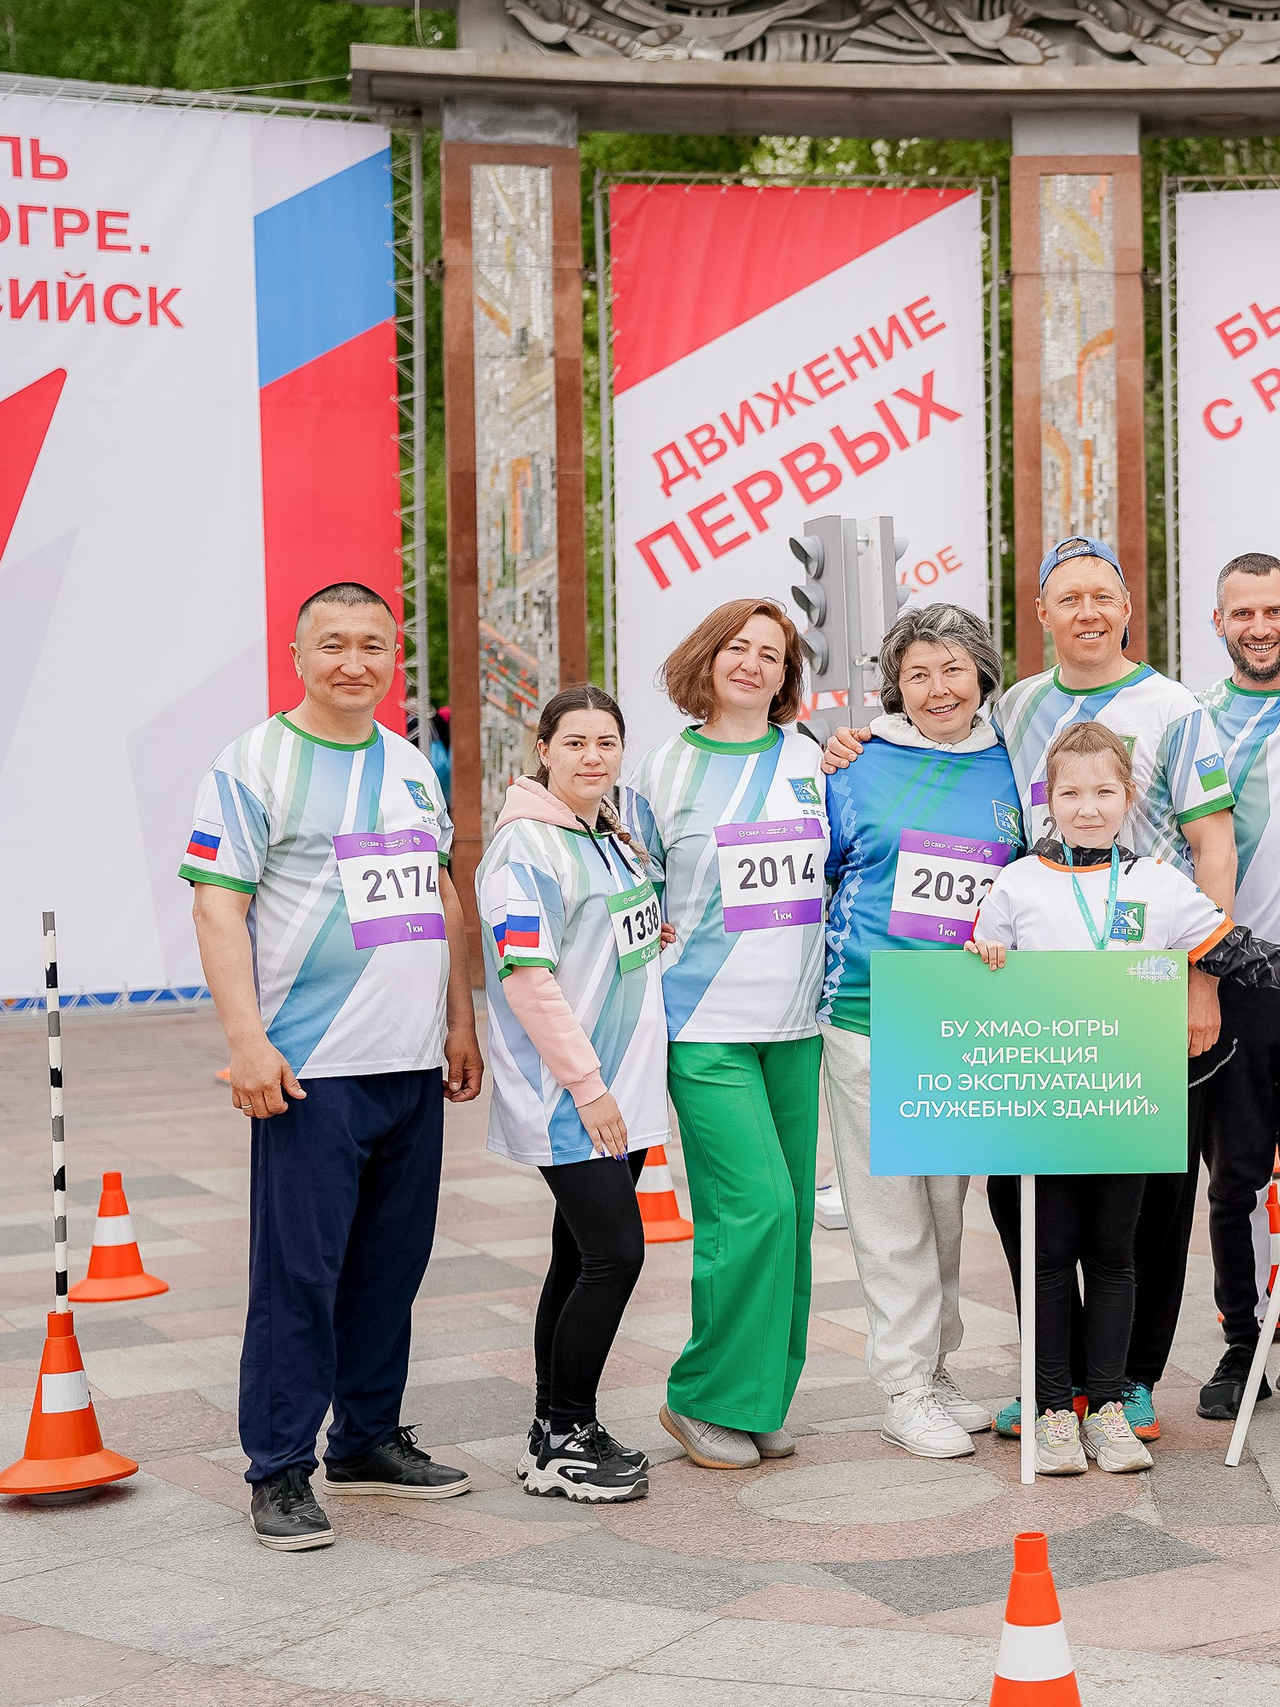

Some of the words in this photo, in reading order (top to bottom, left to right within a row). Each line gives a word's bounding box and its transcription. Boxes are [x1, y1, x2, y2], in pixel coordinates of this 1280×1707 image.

[0, 204, 150, 252] ГРЕ.
[0, 270, 184, 328] ИЙСК
[651, 295, 947, 498] ДВИЖЕНИЕ
[1202, 398, 1244, 442] С
[634, 369, 963, 592] ПЕРВЫХ
[361, 865, 437, 902] 2174
[737, 853, 815, 890] 2014
[622, 901, 659, 945] 1338
[940, 1020, 969, 1038] БУ
[974, 1018, 1119, 1037] ХМАО-ЮГРЫ
[960, 1046, 1098, 1067] «ДИРЕКЦИЯ
[917, 1074, 951, 1091] ПО
[957, 1072, 1142, 1093] ЭКСПЛУАТАЦИИ
[899, 1100, 1046, 1118] СЛУЖЕБНЫХ
[1051, 1095, 1159, 1119] ЗДАНИЙ»
